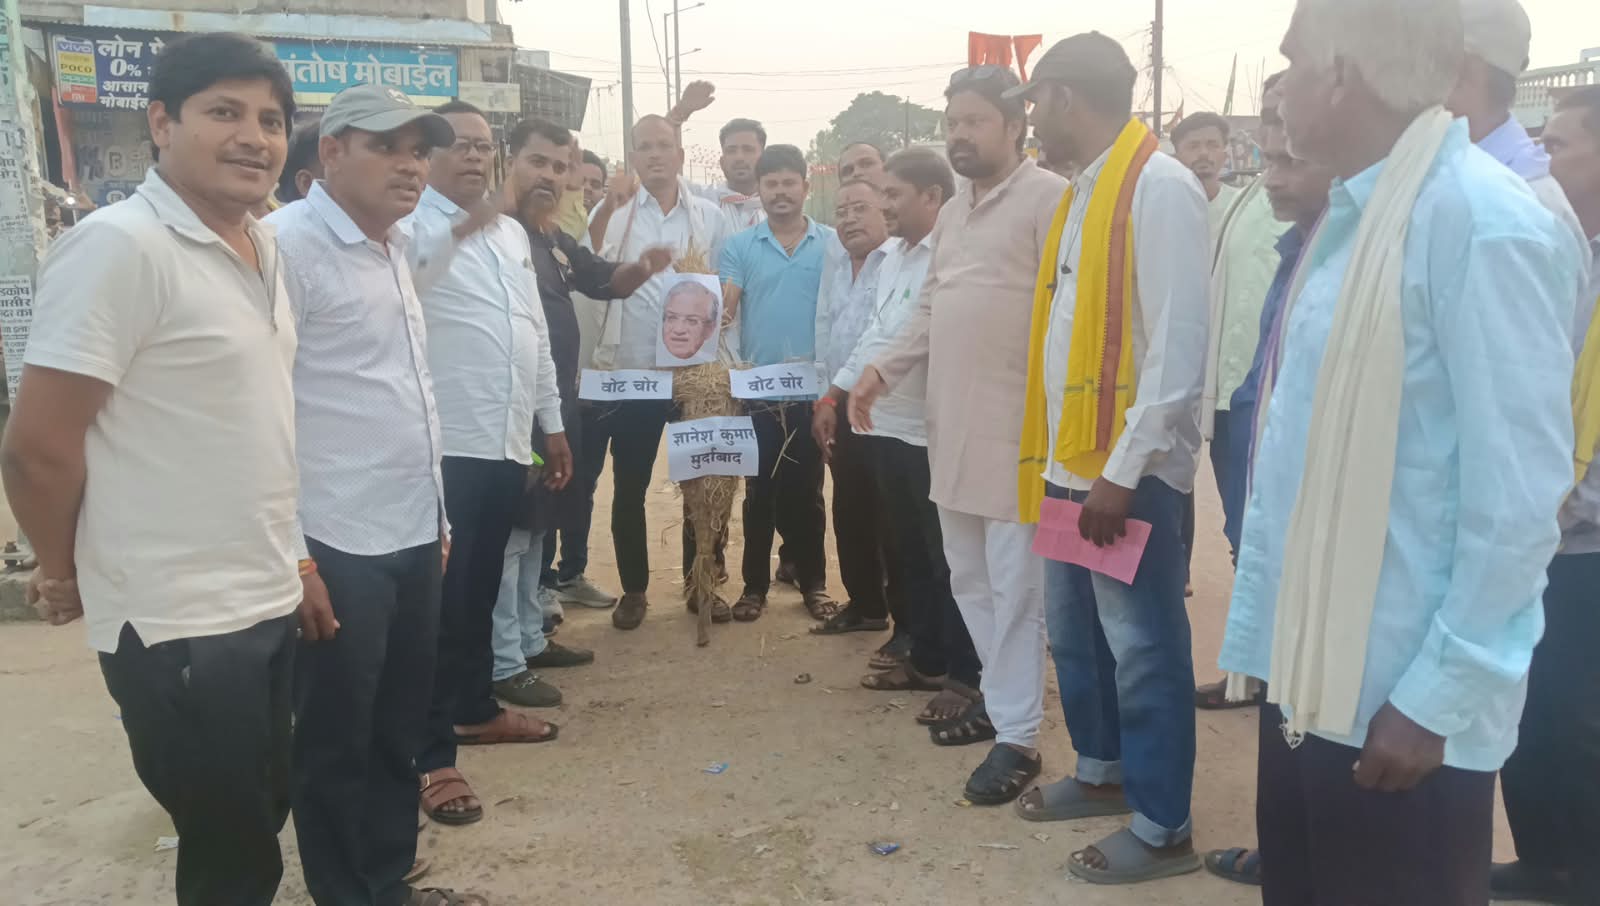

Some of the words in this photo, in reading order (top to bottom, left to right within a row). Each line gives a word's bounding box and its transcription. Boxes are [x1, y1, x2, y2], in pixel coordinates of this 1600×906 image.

[60, 43, 91, 53] vivo
[96, 35, 143, 58] लोन
[60, 63, 92, 73] POCO
[110, 58, 142, 77] 0%
[351, 54, 453, 91] मोबाईल
[103, 80, 149, 93] आसान
[601, 378, 626, 393] वोट
[633, 376, 659, 393] चोर
[748, 377, 775, 393] वोट
[779, 372, 803, 389] चोर
[672, 427, 714, 446] ज्ञानेश
[720, 428, 756, 446] कुमार
[690, 447, 743, 470] मुर्दाबाद
